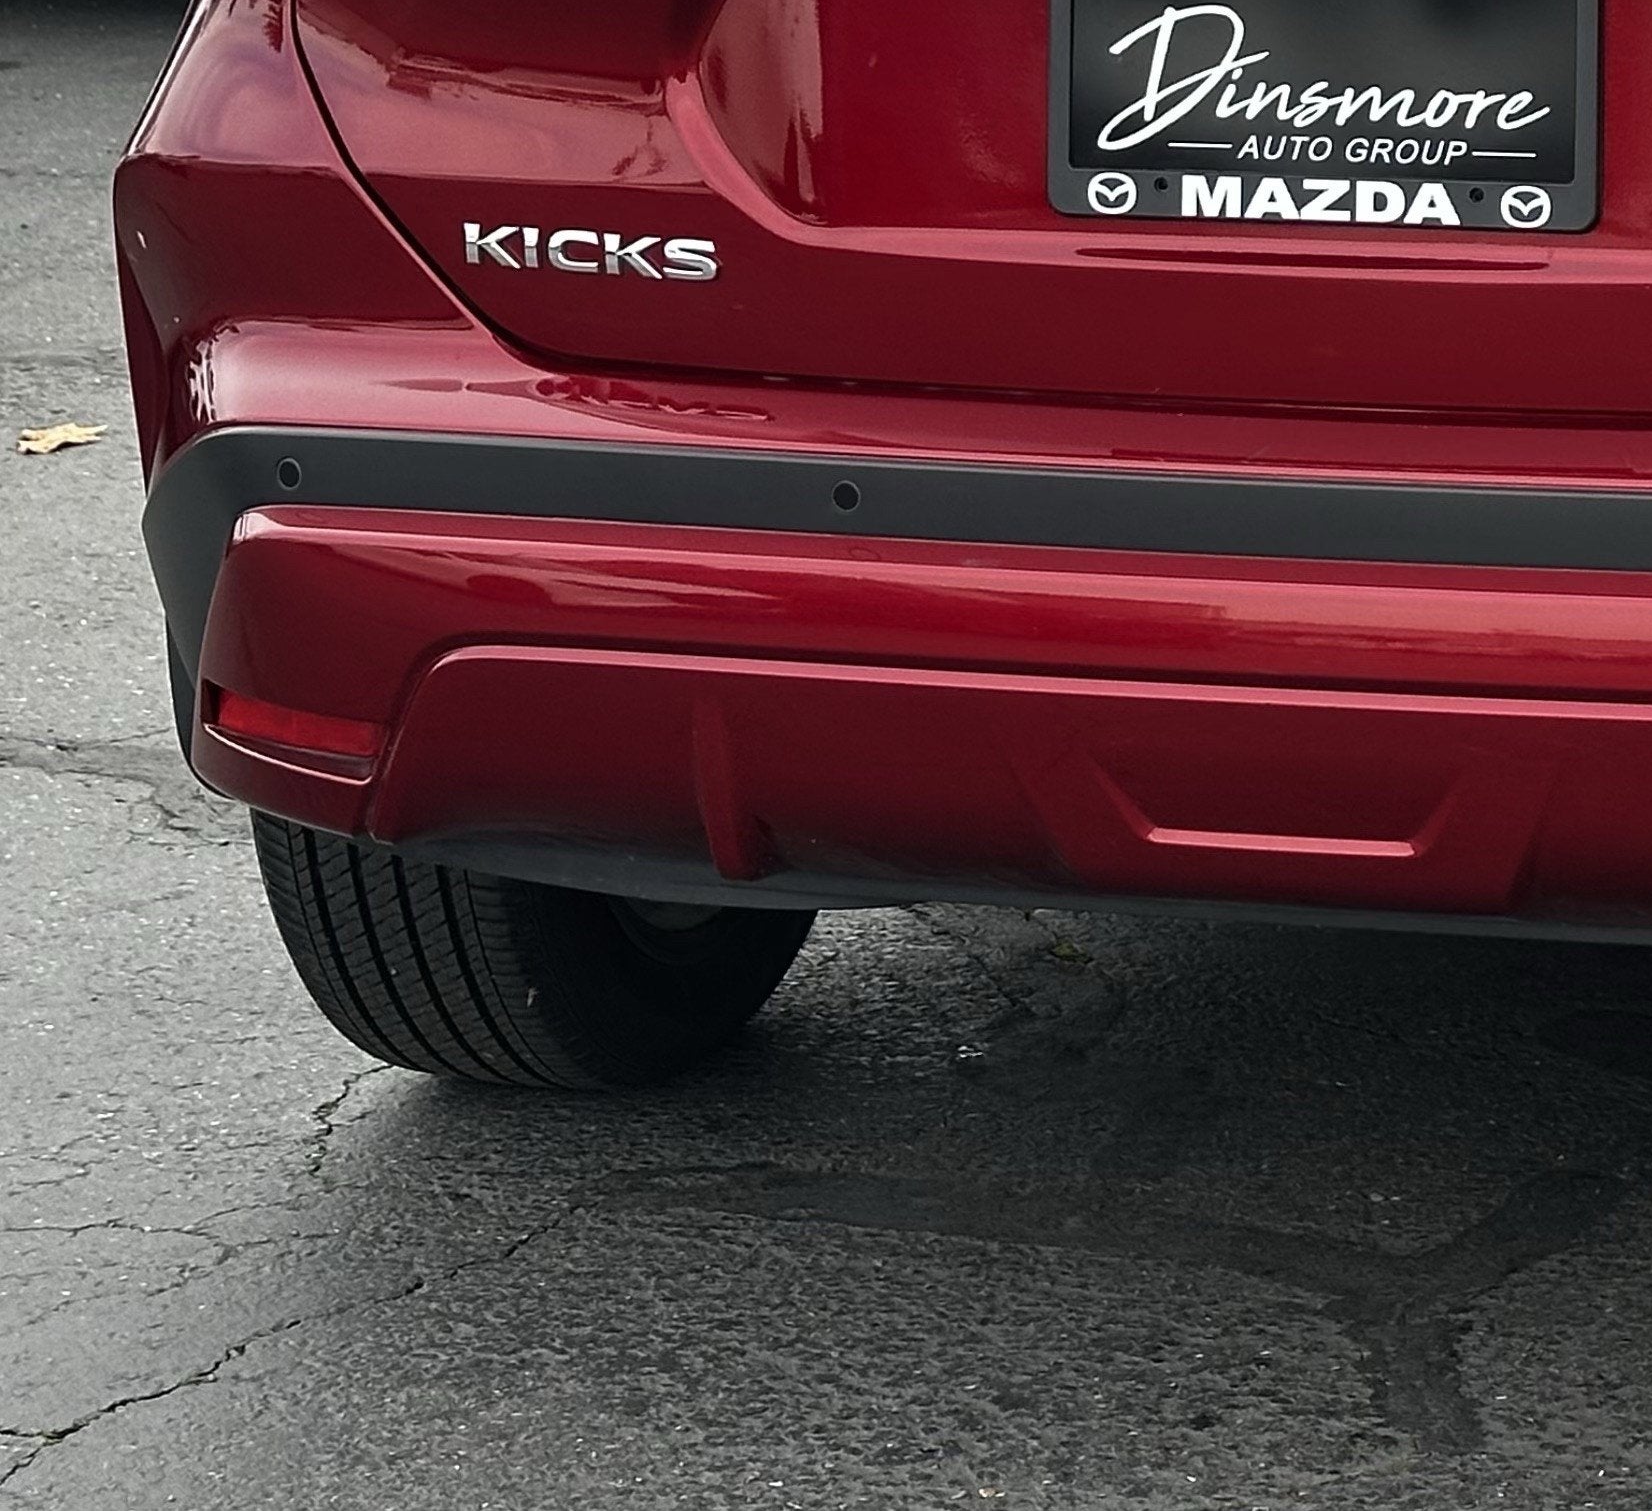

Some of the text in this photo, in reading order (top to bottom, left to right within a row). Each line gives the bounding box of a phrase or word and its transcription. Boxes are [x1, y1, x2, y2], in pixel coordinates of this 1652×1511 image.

[1096, 4, 1552, 152] Dinsmore
[1237, 135, 1470, 167] AUTO GROUP
[1180, 174, 1462, 226] MAZDA
[463, 222, 721, 281] KICKS
